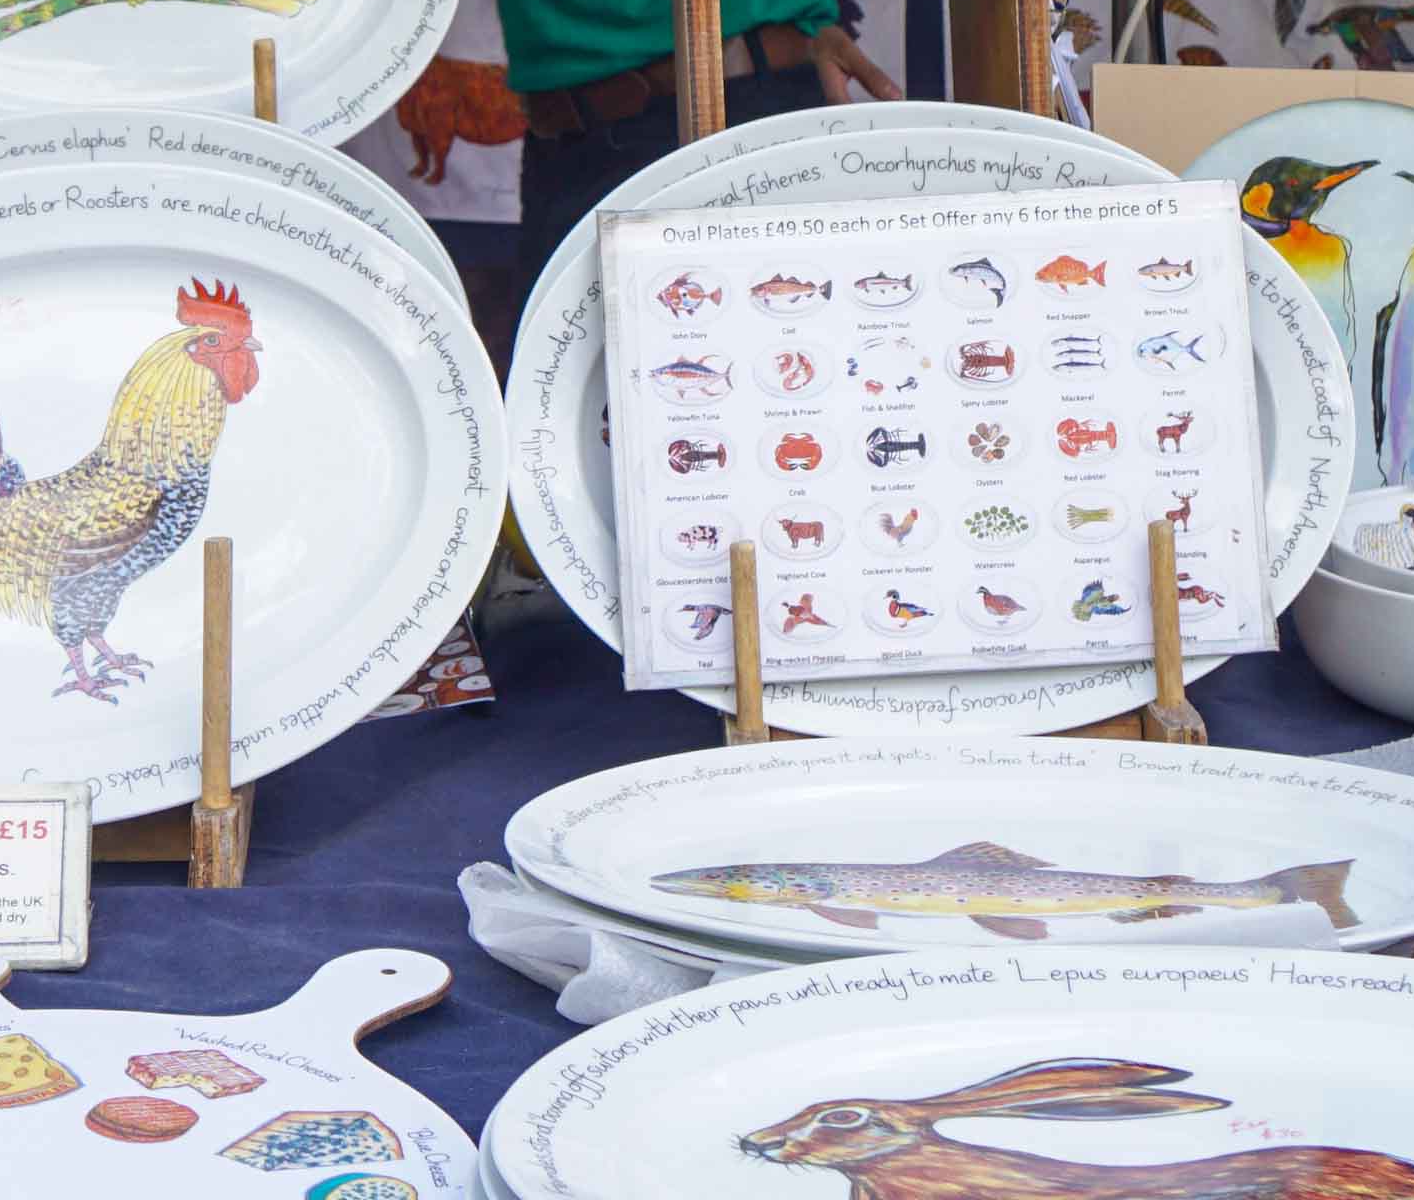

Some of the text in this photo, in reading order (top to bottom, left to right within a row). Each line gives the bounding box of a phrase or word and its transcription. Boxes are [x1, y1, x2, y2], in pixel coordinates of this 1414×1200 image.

[149, 131, 185, 152] Red
[192, 136, 230, 159] deer
[230, 148, 254, 165] are
[256, 156, 282, 177] one
[281, 163, 307, 186] of
[303, 166, 332, 193] the
[833, 145, 976, 191] 'Oncorhynchus
[663, 200, 1179, 243] Oval Plates £49.50 each or Set Offer any 6 for the price of 5
[42, 198, 57, 212] or
[161, 196, 189, 213] are
[198, 198, 241, 222] male
[245, 205, 318, 246] chickens
[316, 230, 351, 267] that
[350, 254, 385, 291] have
[385, 278, 435, 333] vibrant
[1260, 276, 1342, 580] to the west coast of North America
[1118, 752, 1237, 779] Brown trout
[728, 957, 1257, 1028] paws until ready to mate 'Lepus europaeus'
[1269, 961, 1345, 987] Hares
[1346, 966, 1414, 997] reach
